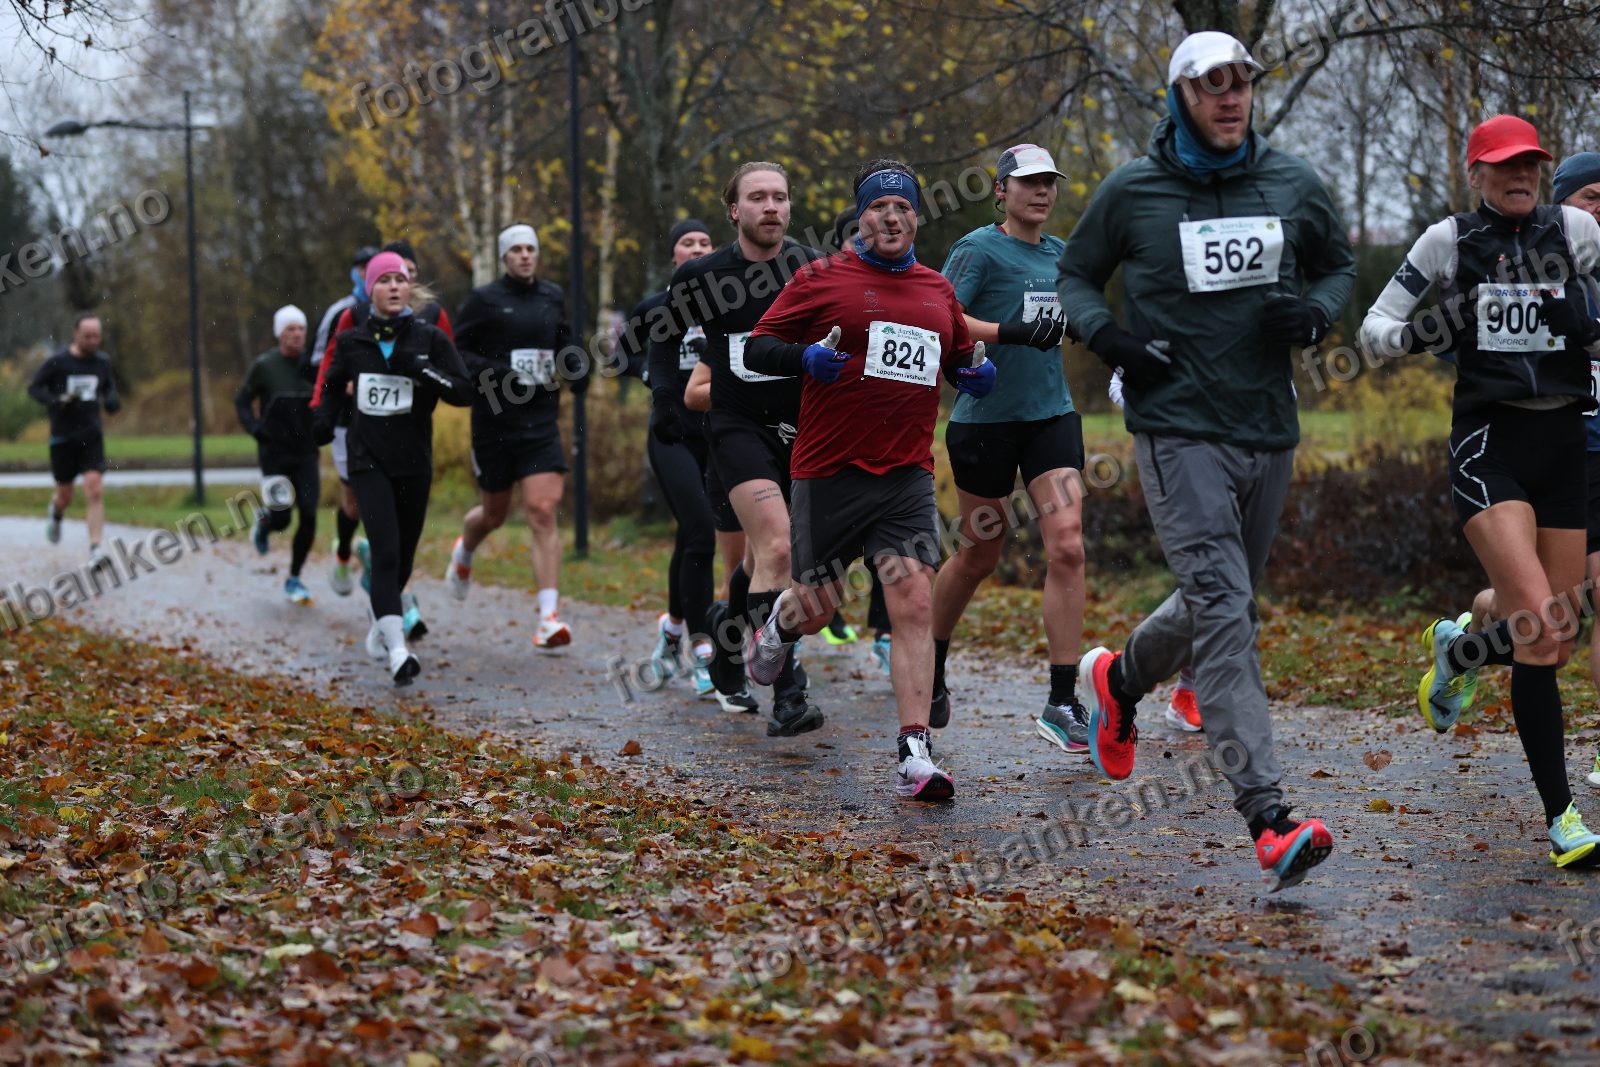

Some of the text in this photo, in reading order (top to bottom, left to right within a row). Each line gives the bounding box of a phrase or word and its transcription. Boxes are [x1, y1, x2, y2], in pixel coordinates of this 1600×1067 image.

[1204, 237, 1264, 274] 562
[881, 339, 926, 372] 824
[368, 386, 399, 406] 671
